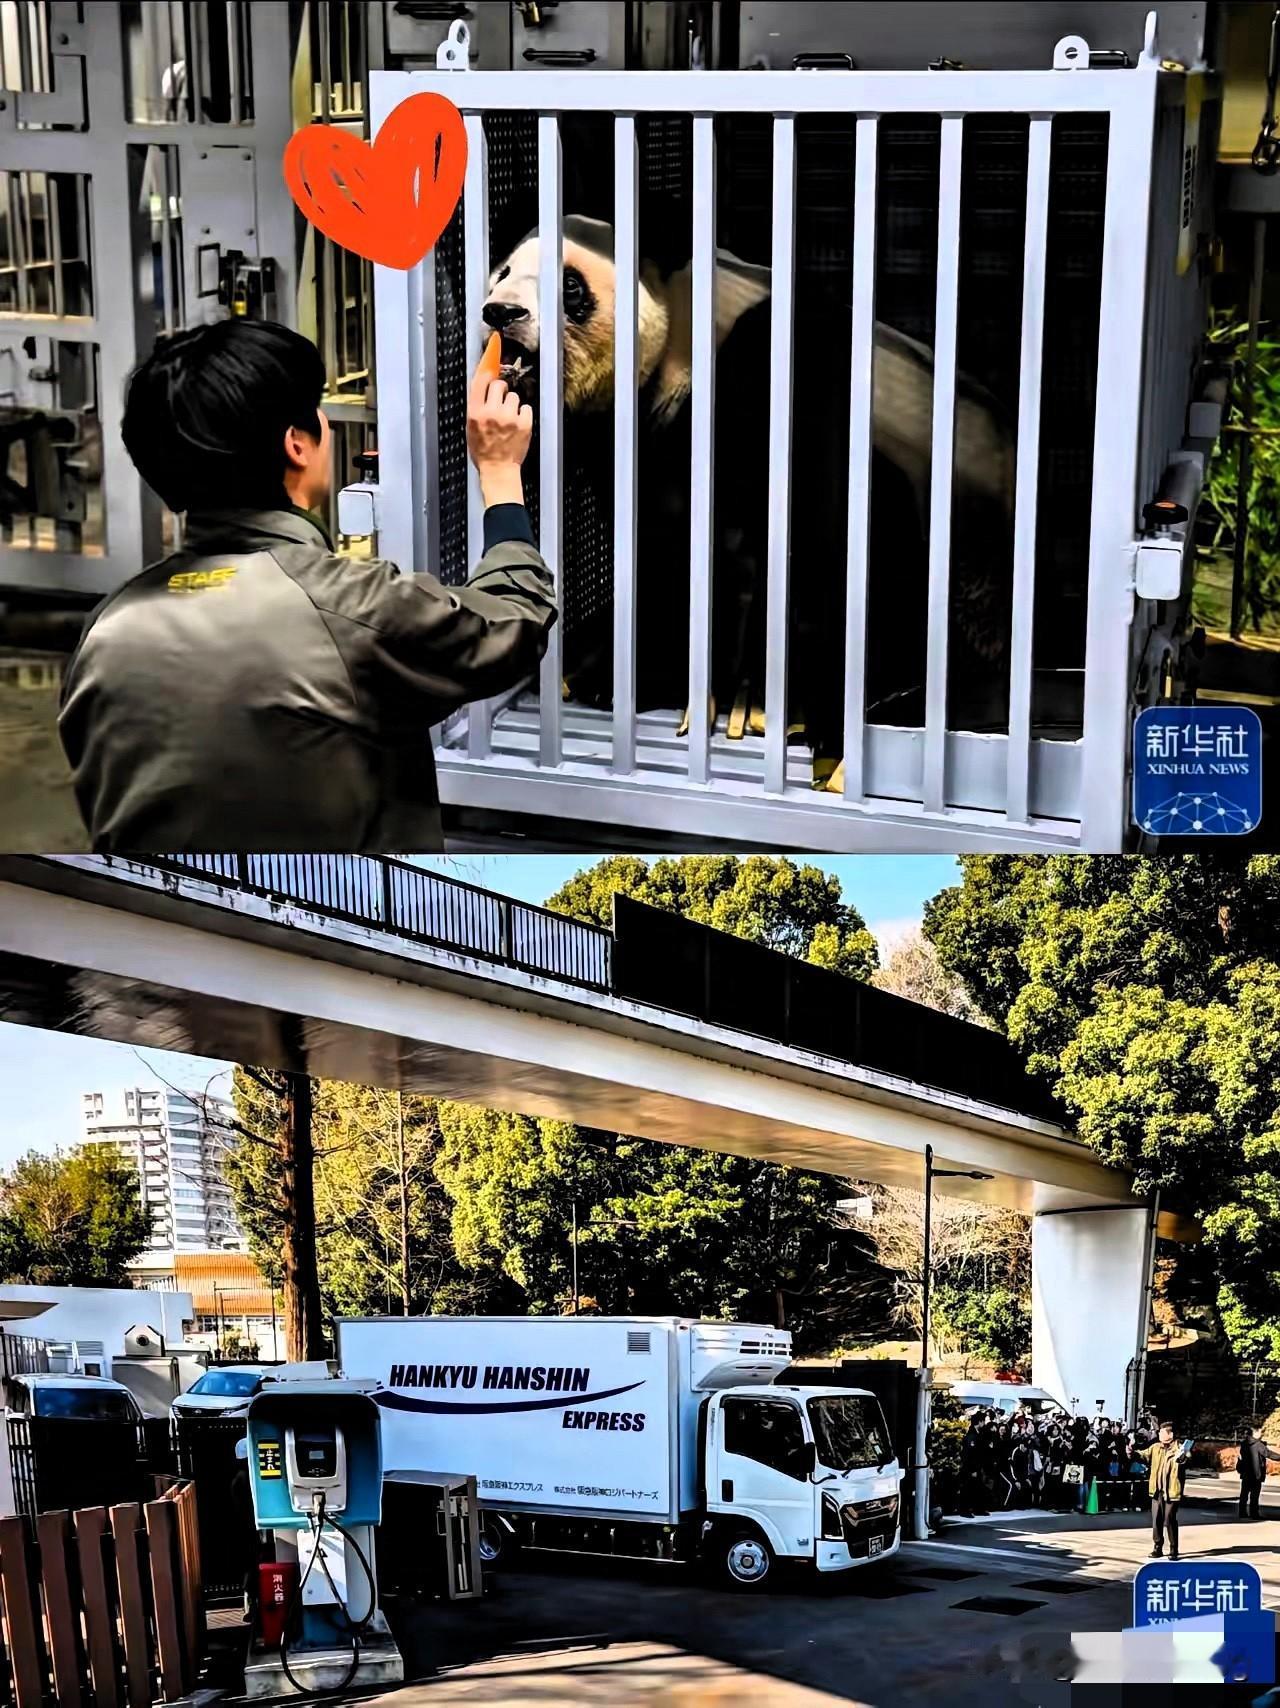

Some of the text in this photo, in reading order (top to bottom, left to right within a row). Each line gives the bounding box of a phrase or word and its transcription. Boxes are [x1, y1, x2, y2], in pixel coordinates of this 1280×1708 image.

[389, 1364, 590, 1392] HANKYU HANSHIN
[562, 1410, 646, 1432] EXPRESS
